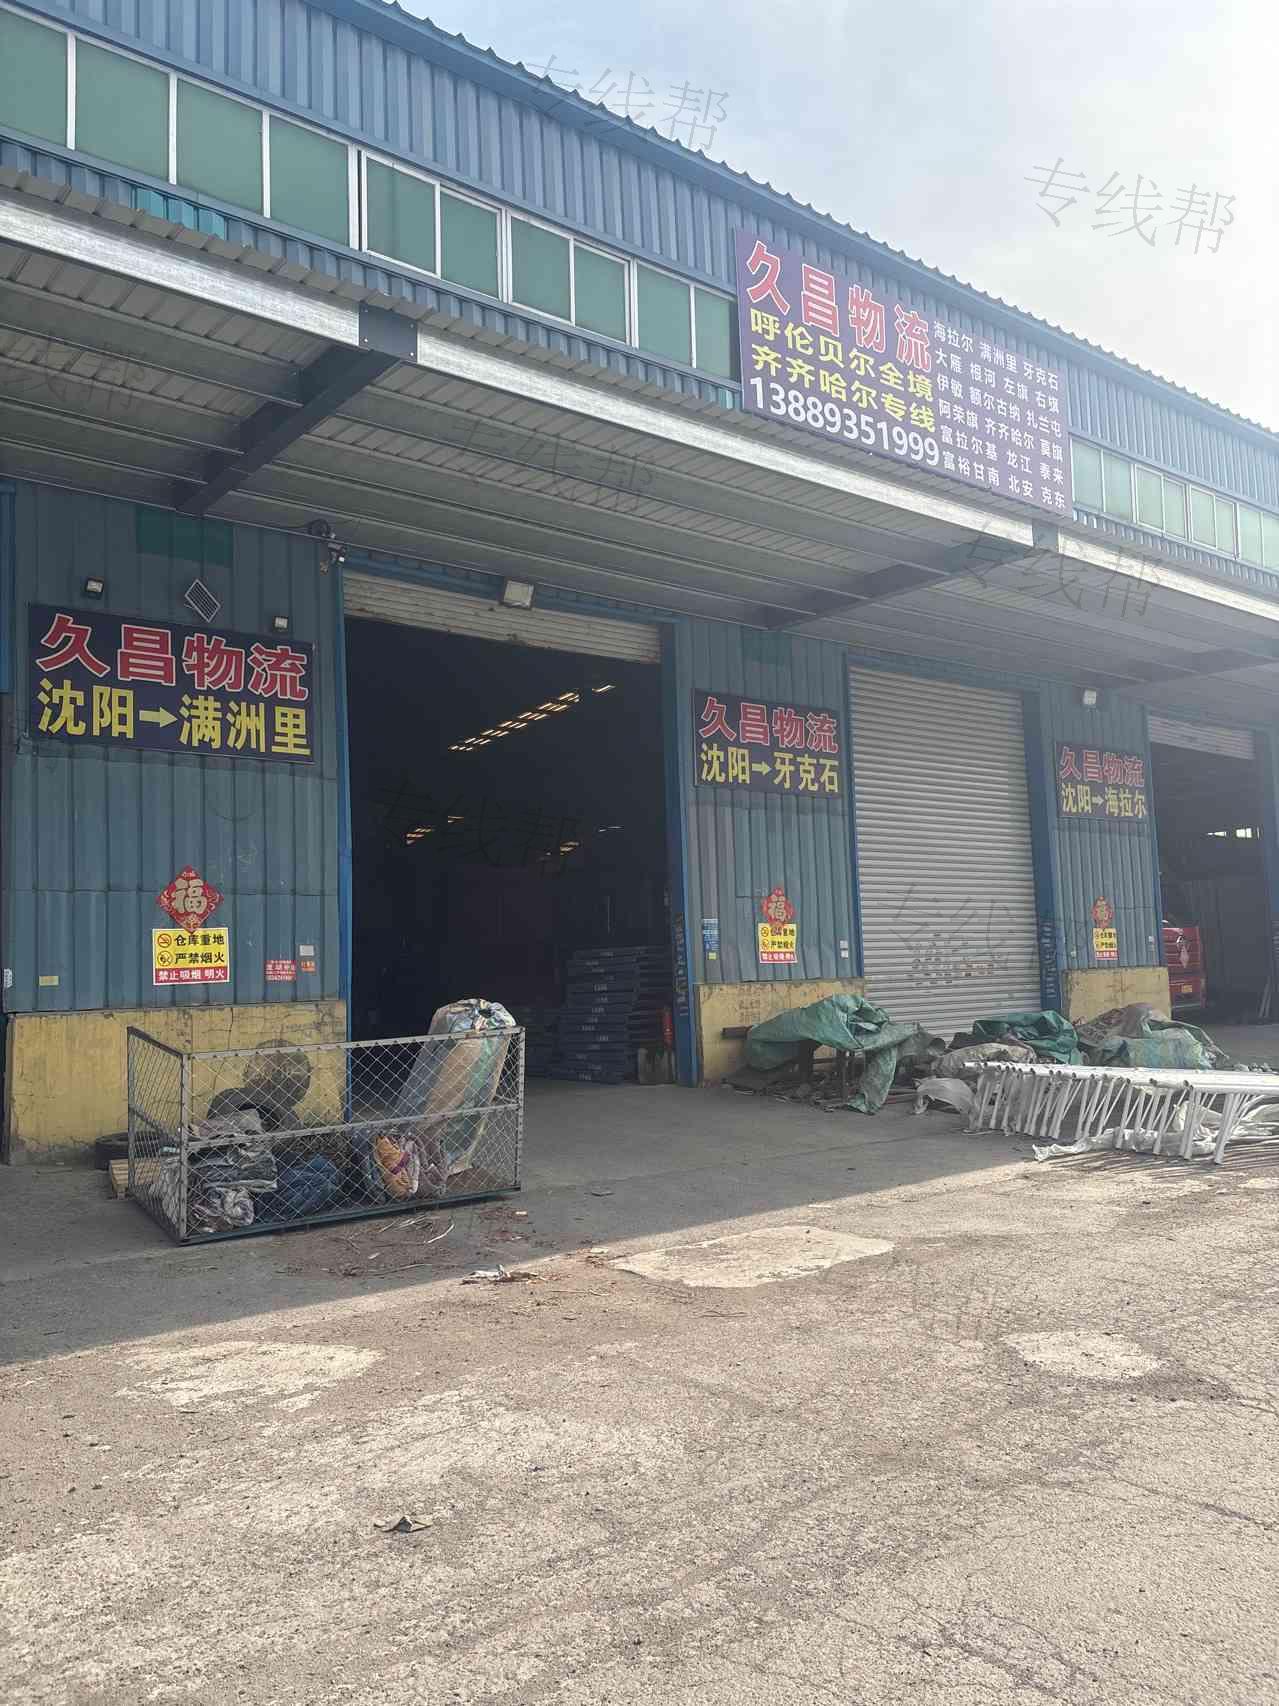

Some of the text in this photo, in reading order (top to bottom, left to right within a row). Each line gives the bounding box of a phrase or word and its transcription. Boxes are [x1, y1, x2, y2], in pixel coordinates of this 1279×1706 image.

[746, 240, 932, 373] 久昌物流
[750, 308, 934, 402] 呼伦贝尔全境
[933, 320, 1059, 392] 海拉尔 满洲里 牙克石
[751, 343, 936, 433] 齐齐哈尔专线
[969, 386, 1021, 422] 额尔古纳
[1025, 409, 1062, 439] 扎兰屯
[750, 376, 940, 467] 13889351999
[938, 398, 979, 429] 阿荣旗
[984, 417, 1034, 449] 齐齐哈尔
[940, 424, 998, 462] 富拉尔基
[36, 613, 309, 701] 久昌物流
[37, 678, 312, 756] 沈阳 满洲里
[699, 696, 839, 754] 久昌物流
[700, 742, 839, 793] 沈阳 牙克石
[1059, 745, 1145, 787] 久昌物流
[1061, 782, 1147, 819] 沈阳 海拉尔
[171, 878, 208, 914] 福
[175, 934, 225, 946] 仓库重地
[175, 952, 225, 964] 严禁烟火
